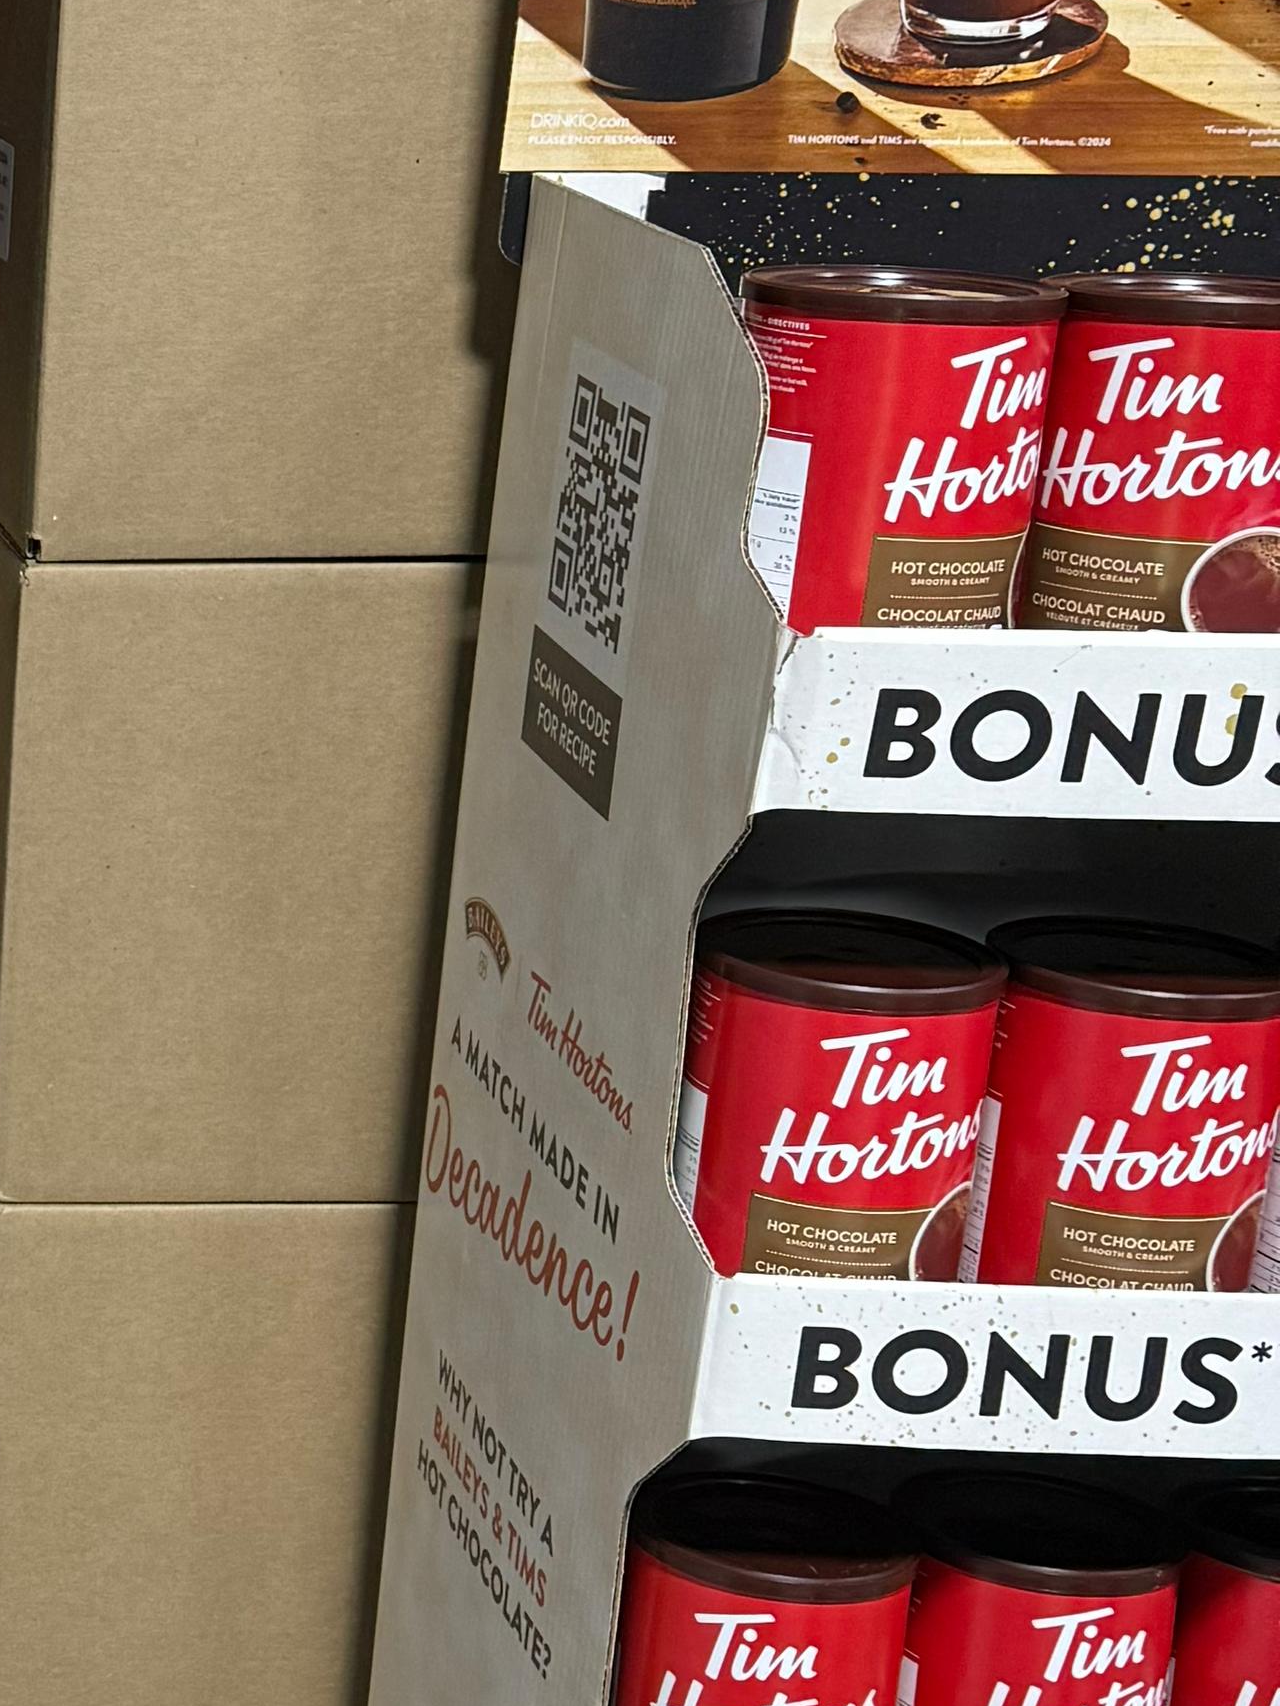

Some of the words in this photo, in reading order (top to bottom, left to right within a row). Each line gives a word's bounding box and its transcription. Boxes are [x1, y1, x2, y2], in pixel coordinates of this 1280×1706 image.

[950, 336, 1046, 430] Tim
[1088, 337, 1224, 424] Tim
[891, 560, 927, 575] HOT
[928, 559, 1006, 576] CHOCOLATE
[1042, 547, 1066, 563] HOT
[1068, 553, 1165, 577] CHOCOLATE
[877, 608, 961, 622] CHOCOLAT
[963, 605, 1002, 621] CHAUD
[1032, 592, 1104, 617] CHOCOLAT
[1106, 605, 1166, 624] CHAUD
[533, 657, 561, 702] SCAN
[562, 683, 578, 717] QR
[578, 699, 612, 746] CODE
[536, 701, 559, 742] FOR
[559, 722, 598, 777] RECIPE
[528, 970, 559, 1050] Tim
[820, 1027, 948, 1109] Tim
[1121, 1034, 1249, 1117] Tim
[451, 1014, 462, 1054] A
[465, 1030, 526, 1133] MATCH
[528, 1110, 589, 1210] MADE
[593, 1184, 620, 1246] IN
[426, 1084, 640, 1362] Decadence!
[766, 1219, 800, 1236] HOT
[803, 1226, 897, 1244] CHOCOLATE
[1063, 1227, 1098, 1243] HOT
[1100, 1234, 1196, 1252] CHOCOLATE
[439, 1348, 472, 1424] WHY
[472, 1404, 507, 1479] NOT
[508, 1457, 540, 1528] TRY
[540, 1514, 554, 1557] A
[433, 1404, 490, 1520] BAILEYS
[507, 1519, 547, 1608] TIMS
[417, 1438, 447, 1510] HOT
[447, 1494, 552, 1681] CHOCOLATE?
[693, 1612, 818, 1682] Tim
[1031, 1606, 1147, 1683] Tim
